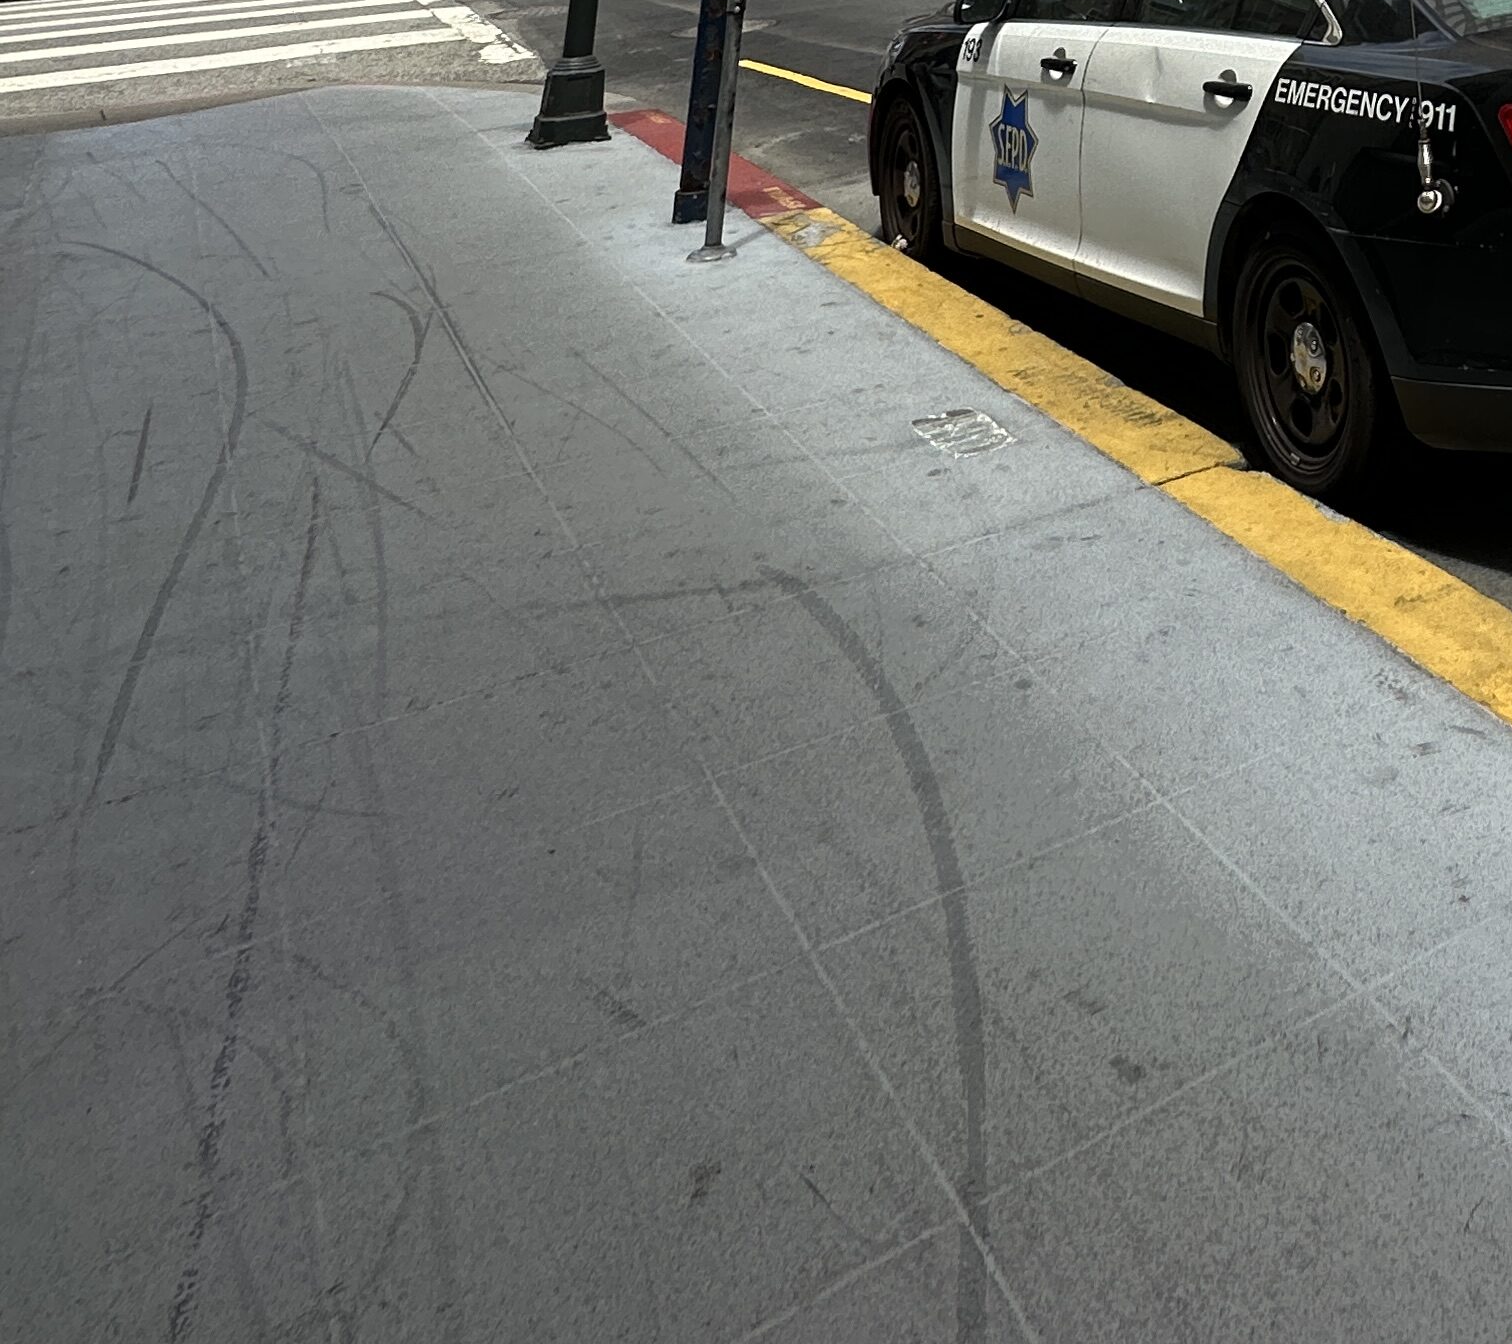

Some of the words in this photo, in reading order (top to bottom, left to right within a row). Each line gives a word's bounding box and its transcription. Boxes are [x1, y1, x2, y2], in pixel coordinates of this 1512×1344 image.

[962, 38, 982, 62] 193
[1274, 77, 1409, 123] EMERGENCY
[1417, 100, 1457, 132] 911
